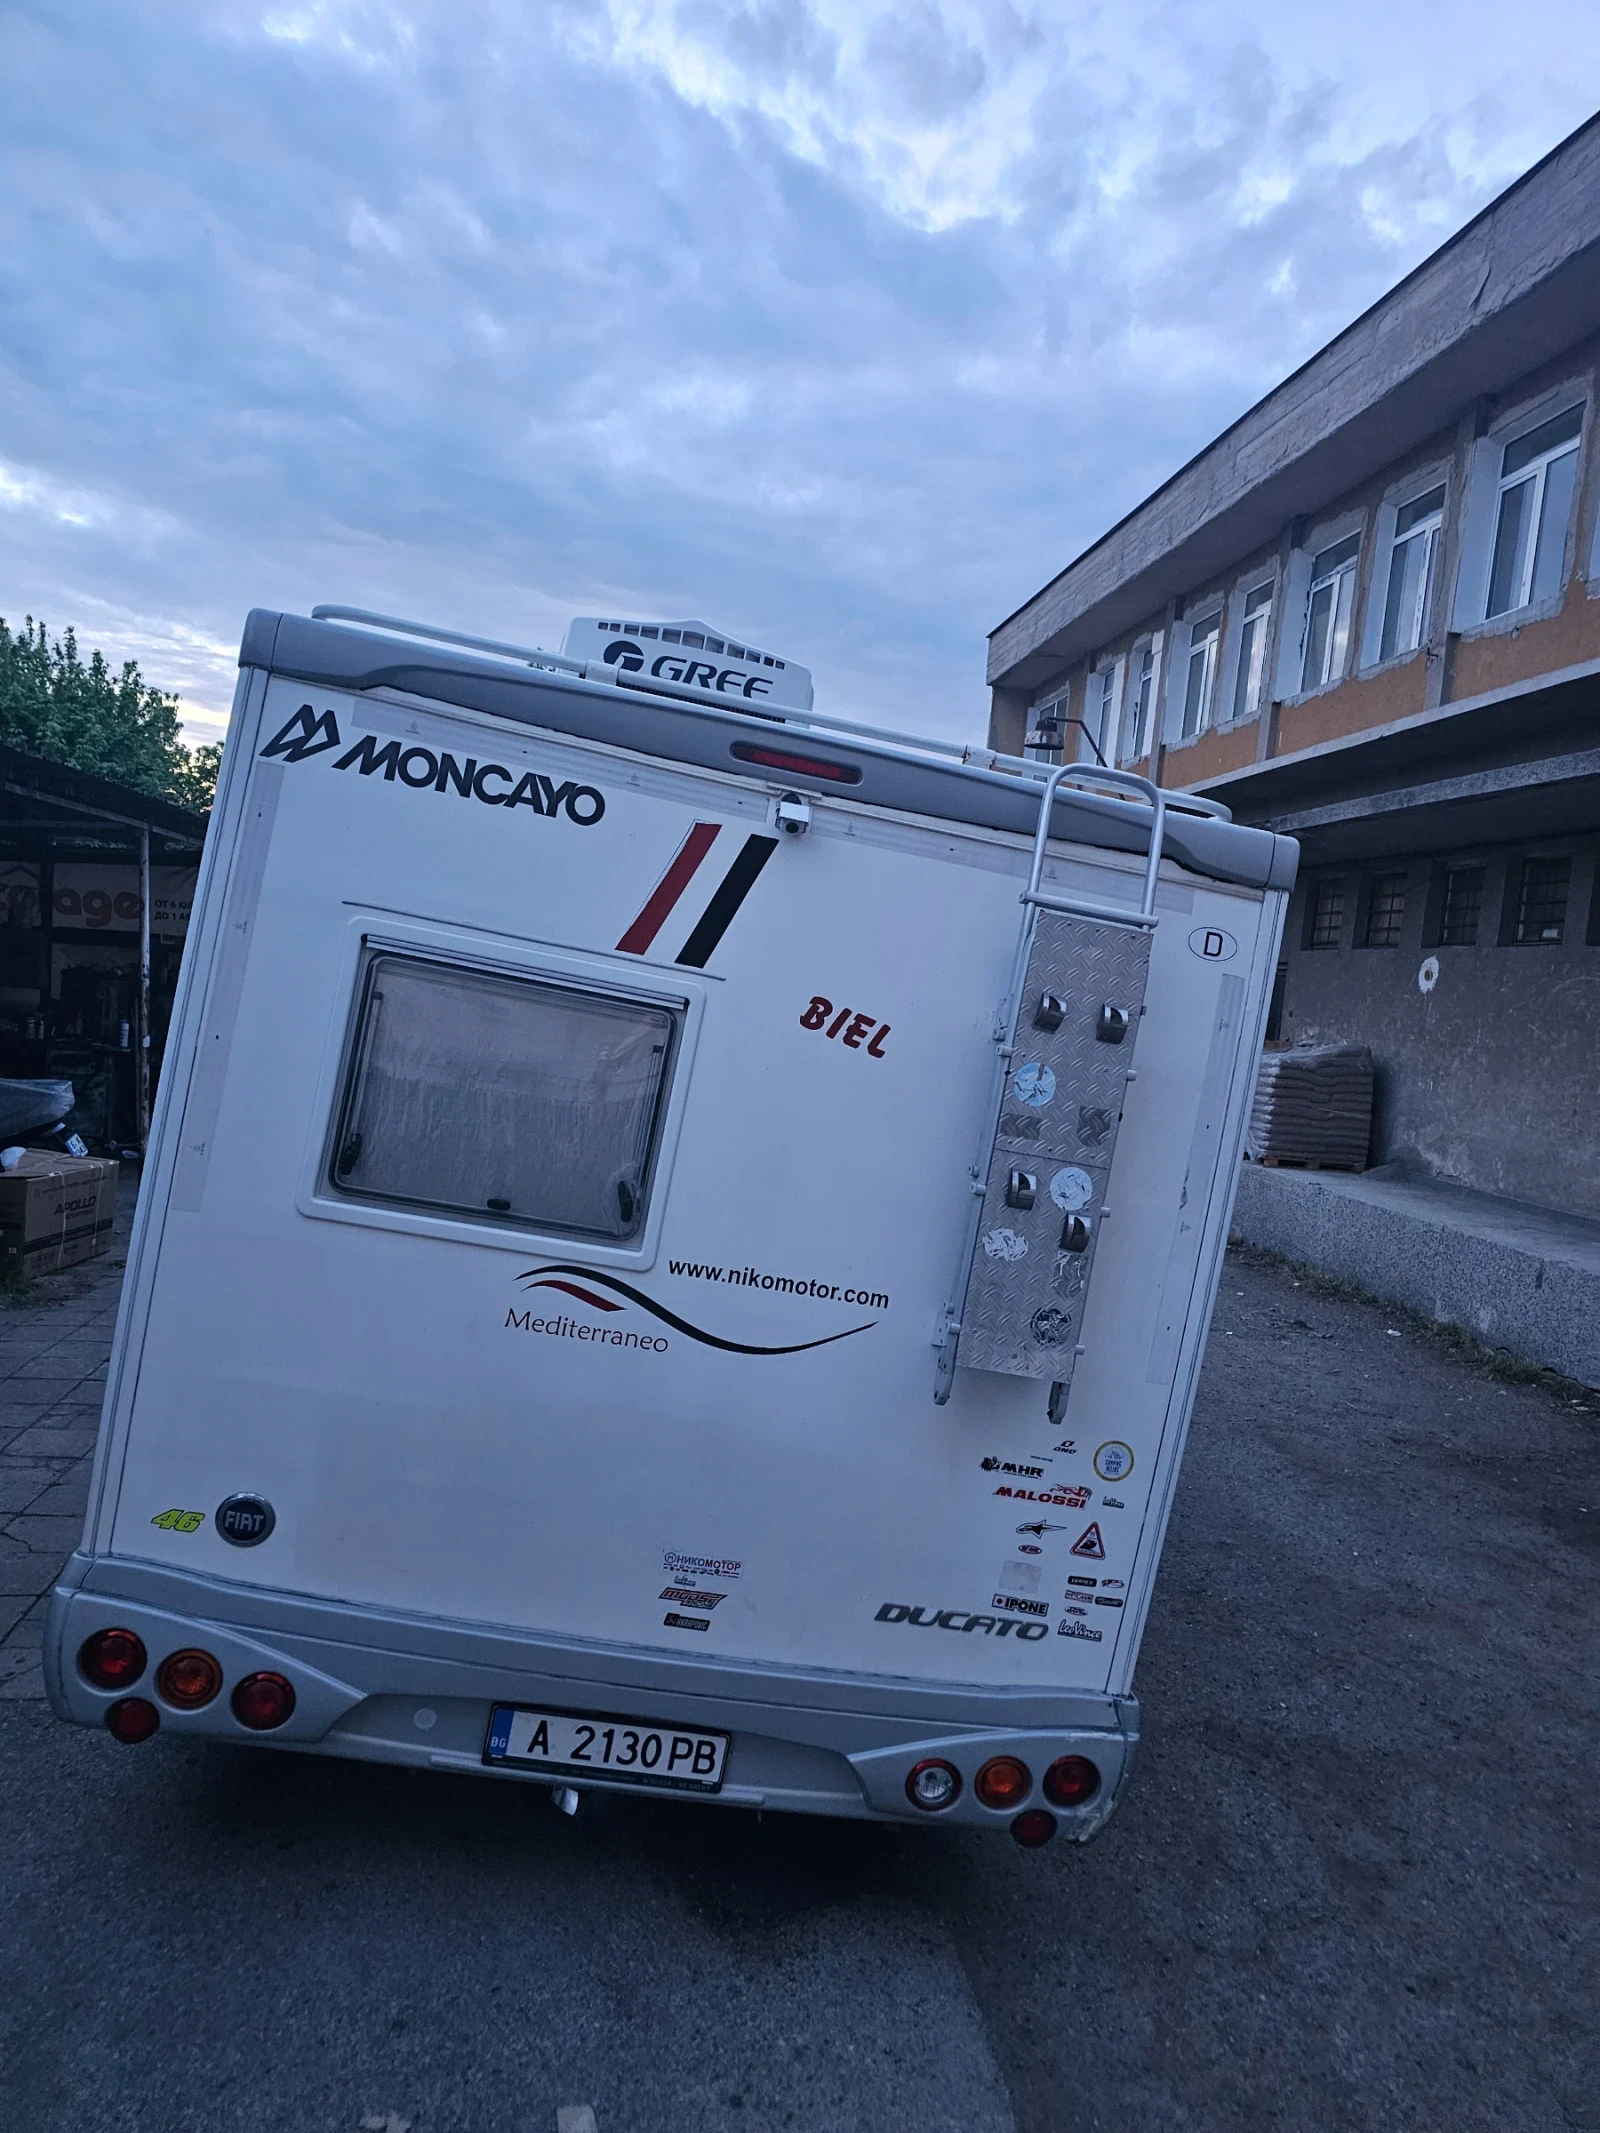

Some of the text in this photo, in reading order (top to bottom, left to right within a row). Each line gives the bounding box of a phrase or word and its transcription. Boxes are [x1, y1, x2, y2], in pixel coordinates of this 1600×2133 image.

[650, 655, 774, 699] GREE
[331, 734, 606, 826] MONCAYO
[170, 901, 176, 909] 6
[1203, 931, 1223, 957] D
[799, 996, 892, 1059] BIEL
[668, 1259, 891, 1309] www.nikomotor.com
[504, 1308, 670, 1354] Mediterraneo
[1000, 1462, 1043, 1477] MHR
[993, 1486, 1088, 1510] MALOSSI
[151, 1508, 206, 1533] 46
[224, 1510, 265, 1532] FIAT
[676, 1554, 742, 1571] НИКОМОТОР
[1004, 1597, 1048, 1615] IPONE
[873, 1602, 1049, 1641] DUCATO
[1057, 1619, 1102, 1641] LeoVince
[490, 1735, 507, 1749] BG
[527, 1720, 549, 1755] A
